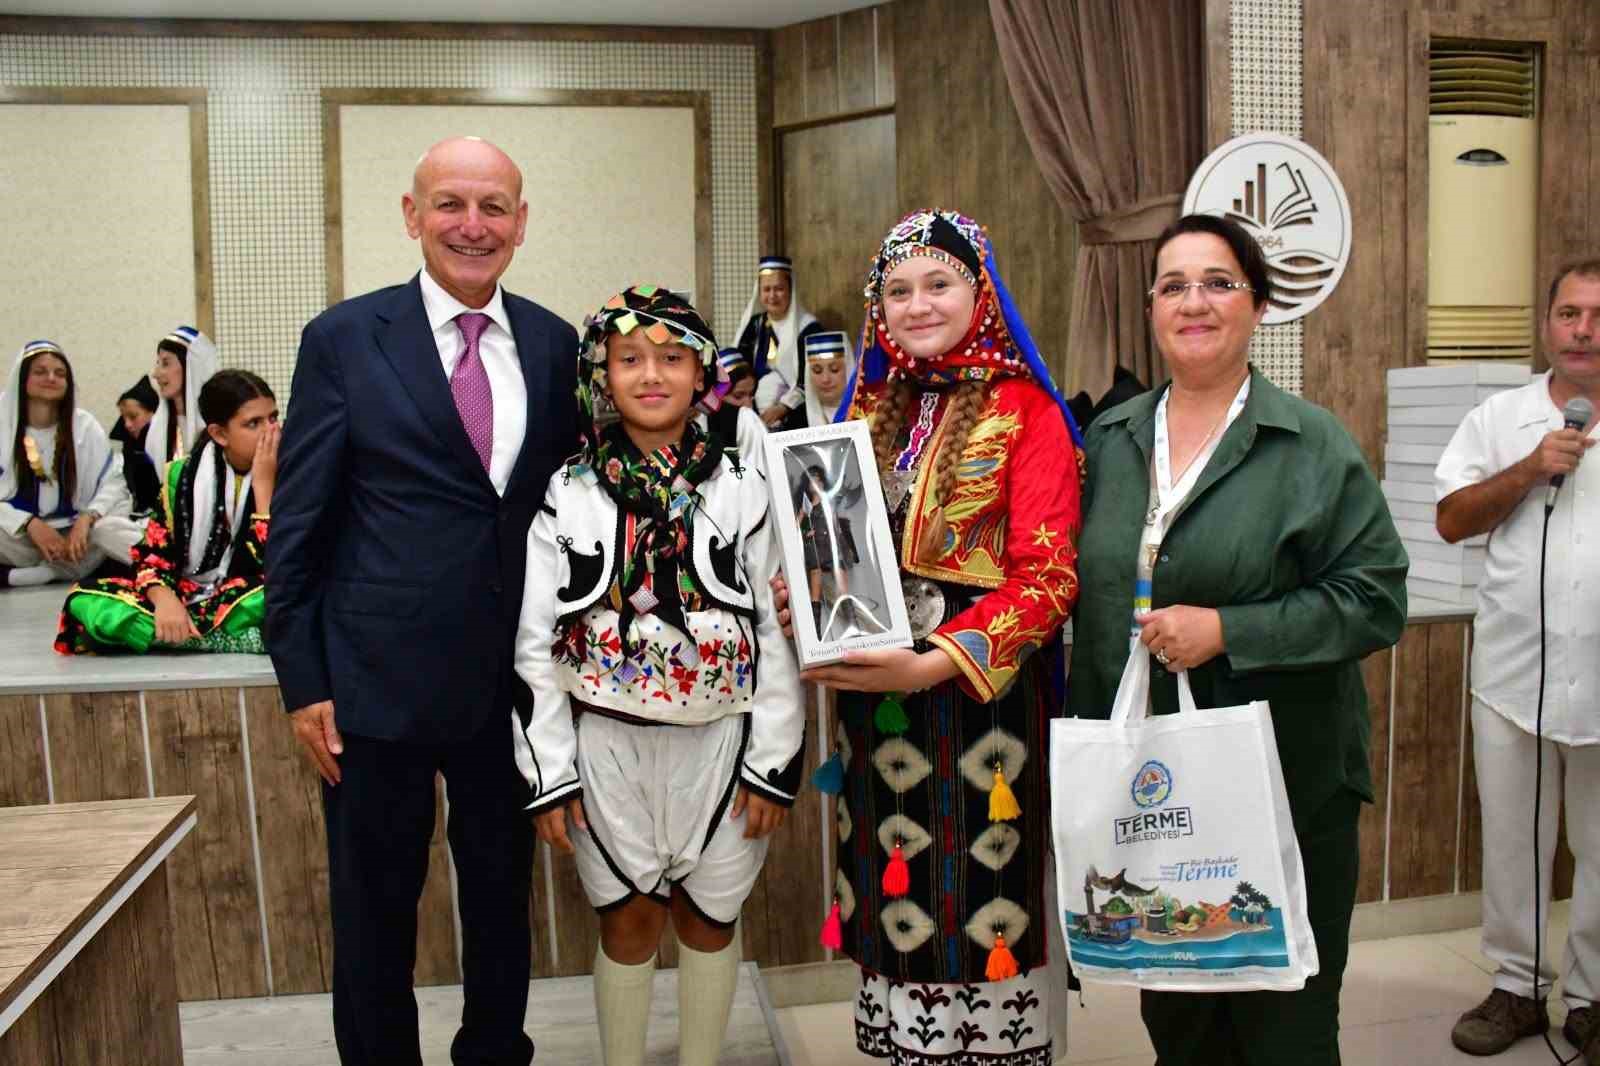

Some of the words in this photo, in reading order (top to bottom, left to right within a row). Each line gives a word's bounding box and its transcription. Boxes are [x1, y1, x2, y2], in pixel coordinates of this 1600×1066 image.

[1257, 236, 1283, 248] 964
[1118, 810, 1188, 836] TERME
[1175, 862, 1238, 882] Terme
